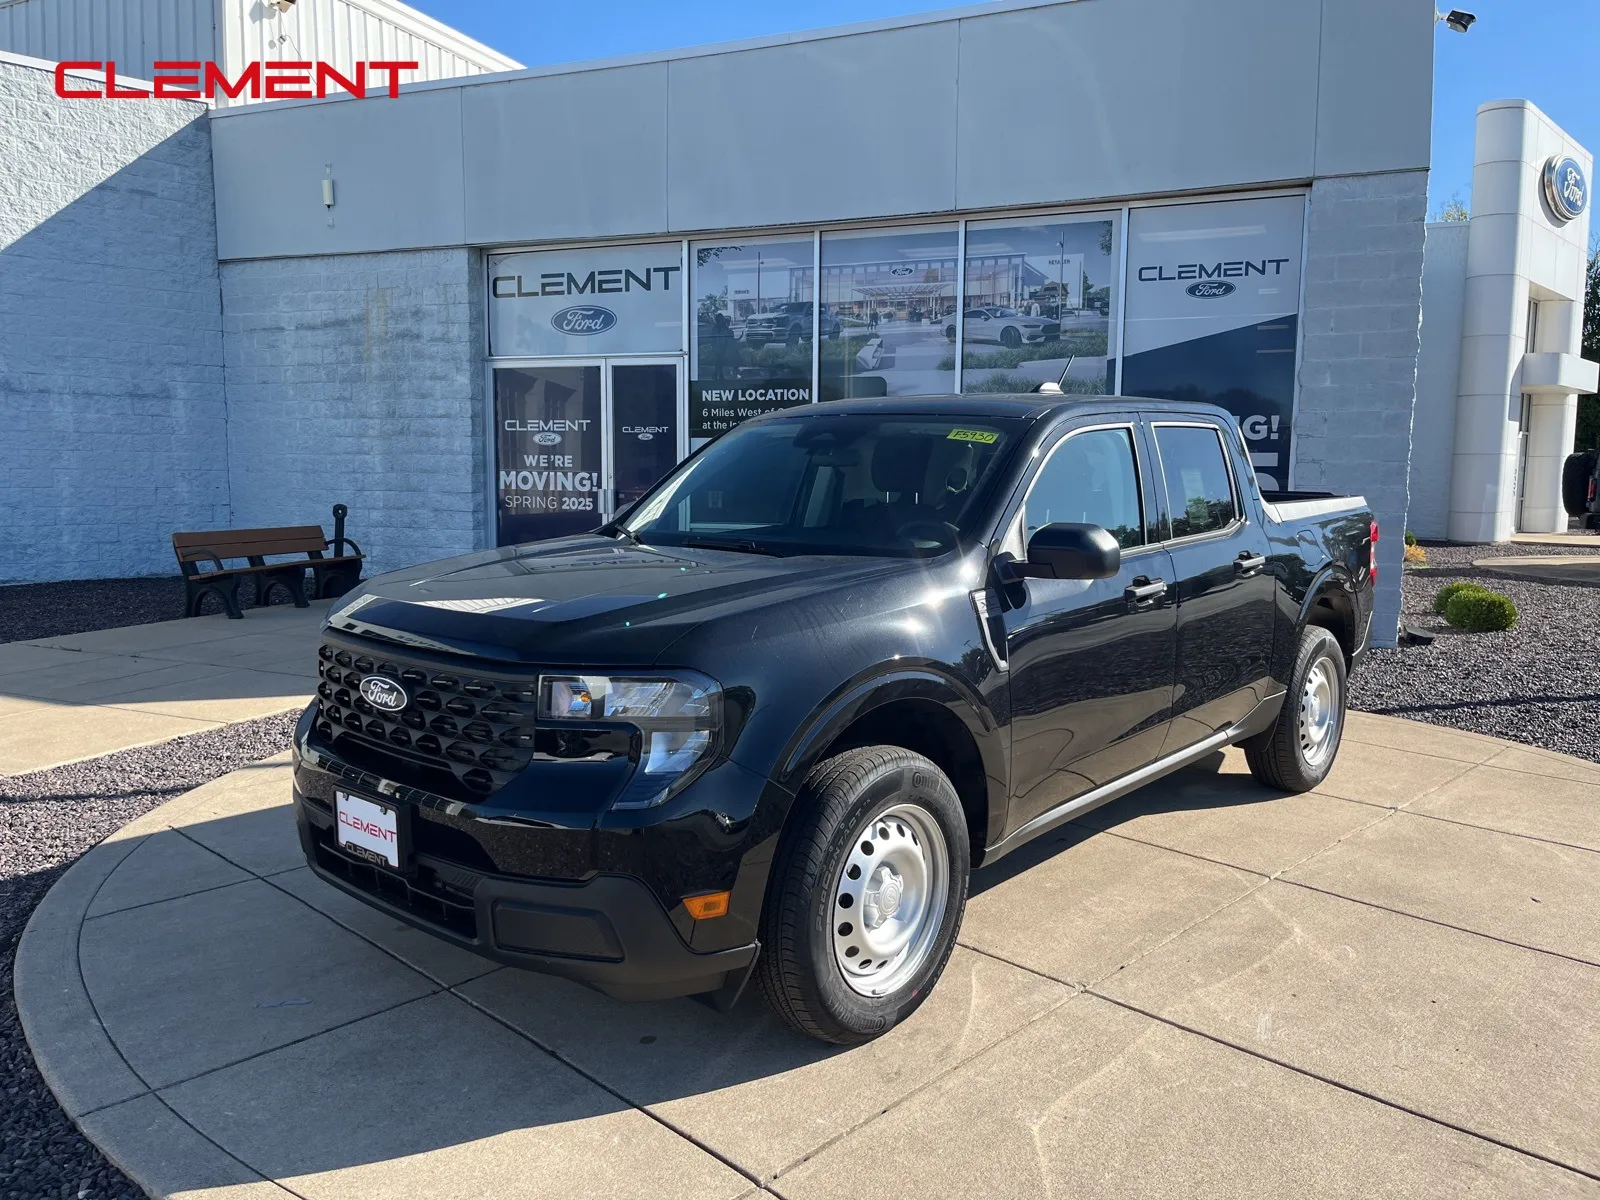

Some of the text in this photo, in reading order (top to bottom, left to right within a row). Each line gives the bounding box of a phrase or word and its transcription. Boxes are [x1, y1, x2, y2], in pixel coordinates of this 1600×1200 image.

[1138, 258, 1290, 282] CLEMENT
[492, 266, 681, 299] CLEMENT
[702, 388, 810, 402] NEW LOCATION
[702, 408, 709, 417] 6
[711, 408, 735, 417] Miles
[737, 408, 761, 417] West
[504, 419, 592, 432] CLEMENT
[622, 426, 669, 434] CLEMENT
[702, 421, 711, 430] at
[713, 421, 728, 430] the
[953, 430, 994, 442] F5930
[523, 454, 573, 468] WE'RE
[500, 470, 599, 493] MOVING!
[505, 495, 594, 511] SPRING 2025
[339, 810, 397, 843] CLEMENT
[345, 842, 387, 867] CLEMENT
